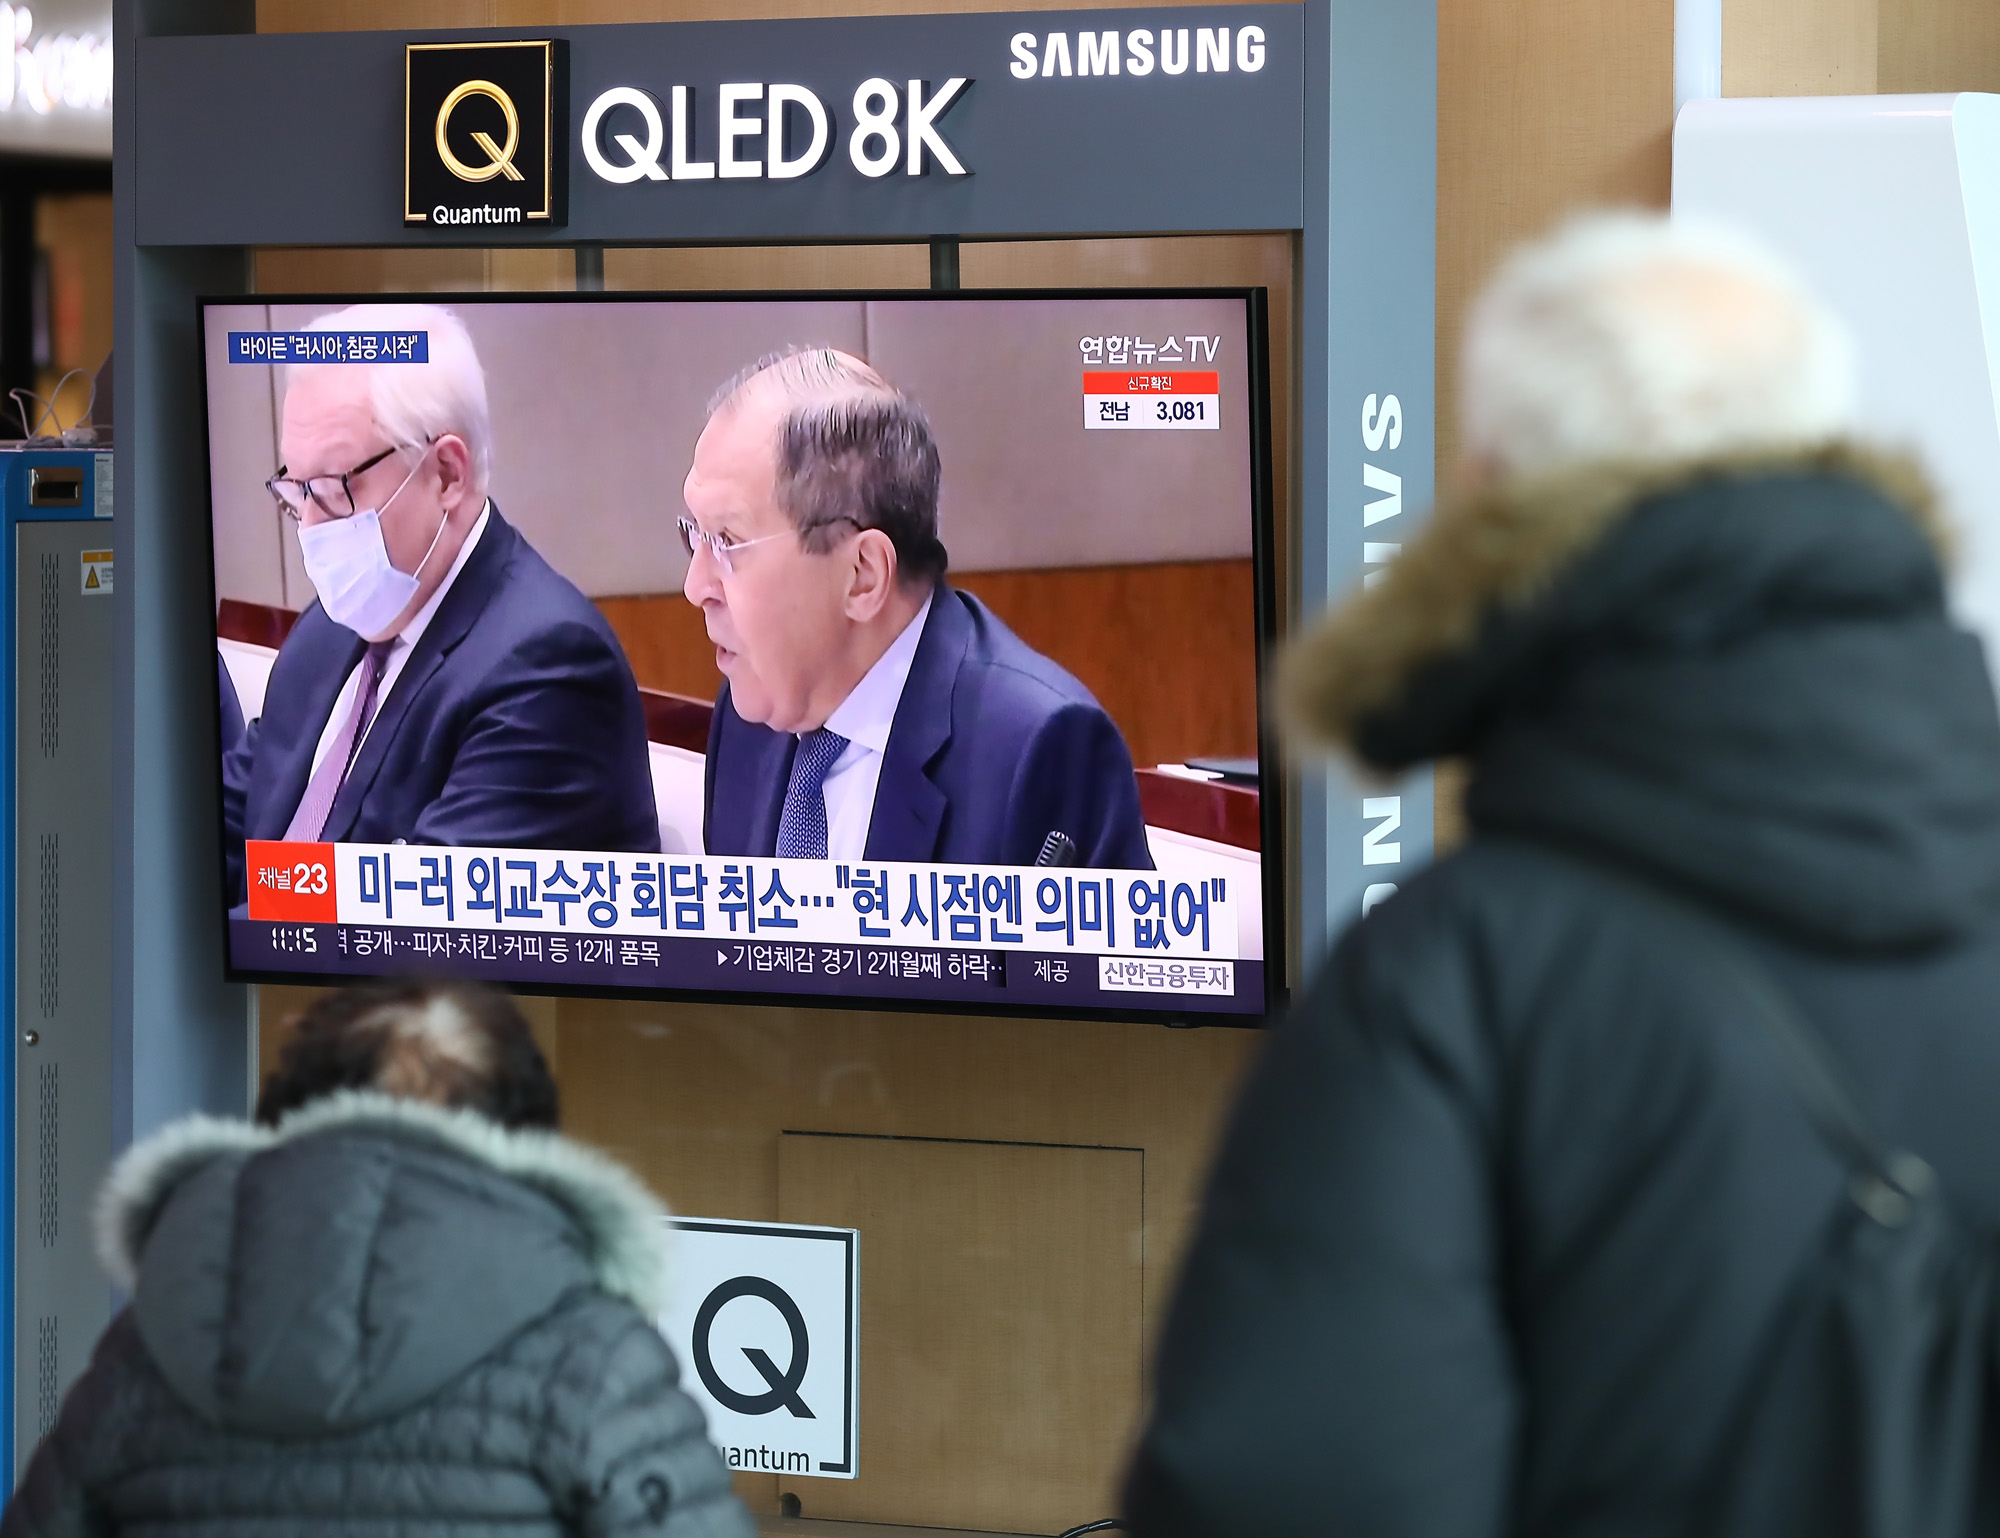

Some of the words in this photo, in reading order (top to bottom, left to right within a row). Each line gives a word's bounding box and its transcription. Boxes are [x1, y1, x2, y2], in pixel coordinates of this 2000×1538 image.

[1009, 25, 1267, 79] SAMSUNG
[434, 79, 526, 182] Q
[581, 83, 828, 184] QLED
[848, 77, 968, 178] 8K
[432, 204, 522, 226] Quantum
[240, 336, 287, 359] 바이든
[381, 335, 418, 359] 시작"
[1079, 335, 1221, 365] 연합뉴스TV
[1128, 376, 1172, 391] 신규확진
[1099, 401, 1130, 422] 전남
[1156, 401, 1205, 423] 3,081
[257, 867, 292, 891] 채널
[293, 862, 329, 895] 23
[358, 852, 454, 922] 미-러
[466, 856, 621, 928] 외교수장
[630, 861, 708, 930] 회담
[901, 871, 1024, 944] 시점엔
[1035, 877, 1115, 948] 의미
[1127, 878, 1226, 951] 없어"
[271, 927, 317, 953] 11:15
[548, 936, 570, 963] 등
[575, 938, 614, 965] 12개
[619, 939, 661, 968] 품목
[732, 944, 816, 974] 기업체감
[820, 948, 862, 976] 경기
[867, 950, 942, 979] 2개월째
[1033, 959, 1071, 984] 제공
[1104, 961, 1231, 992] 신한금융투자
[692, 1275, 817, 1420] Q
[722, 1444, 810, 1473] antum
